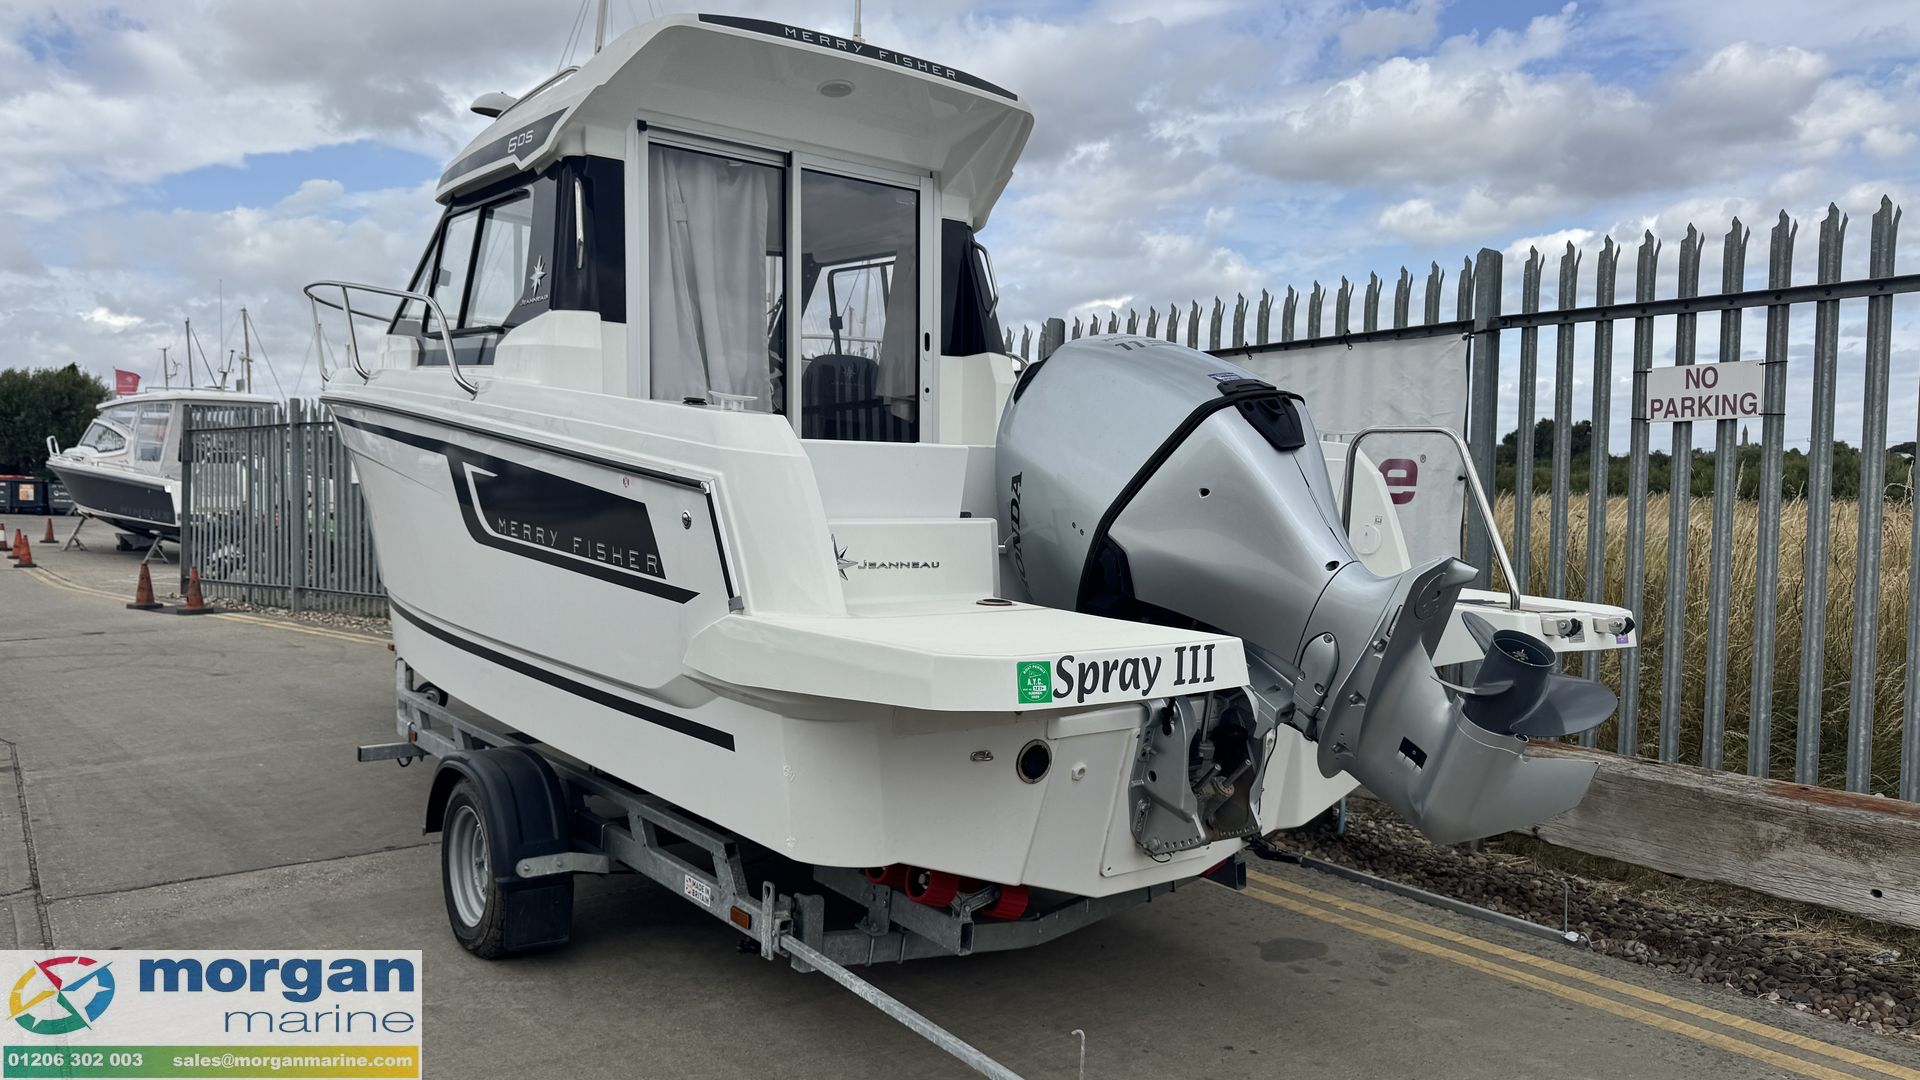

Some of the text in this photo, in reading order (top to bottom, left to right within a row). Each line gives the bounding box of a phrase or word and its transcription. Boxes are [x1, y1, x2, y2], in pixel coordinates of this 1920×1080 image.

[784, 26, 956, 80] MERRY FISHER
[507, 129, 534, 154] 605
[1685, 366, 1719, 390] NO
[1650, 392, 1758, 420] PARKING
[498, 517, 658, 574] MERRY FISHER
[857, 560, 940, 570] JEANNEAU
[1053, 644, 1215, 703] Spray III
[692, 879, 704, 893] MADE
[692, 888, 710, 904] BRITAIN
